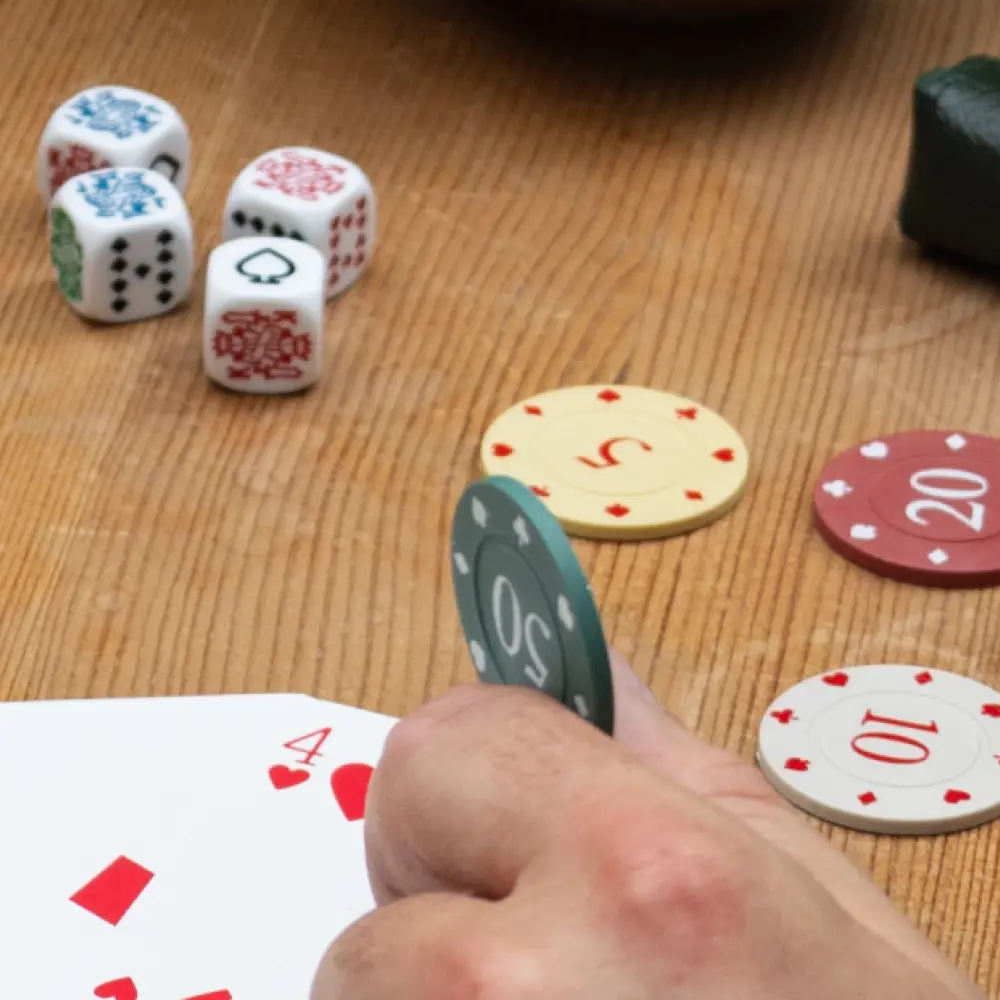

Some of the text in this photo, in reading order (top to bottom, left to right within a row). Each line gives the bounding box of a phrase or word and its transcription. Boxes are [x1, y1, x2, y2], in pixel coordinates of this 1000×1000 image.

[573, 436, 653, 470] 5
[903, 466, 991, 534] 20
[492, 574, 552, 689] 50
[282, 726, 333, 768] 4
[849, 708, 940, 766] 10
